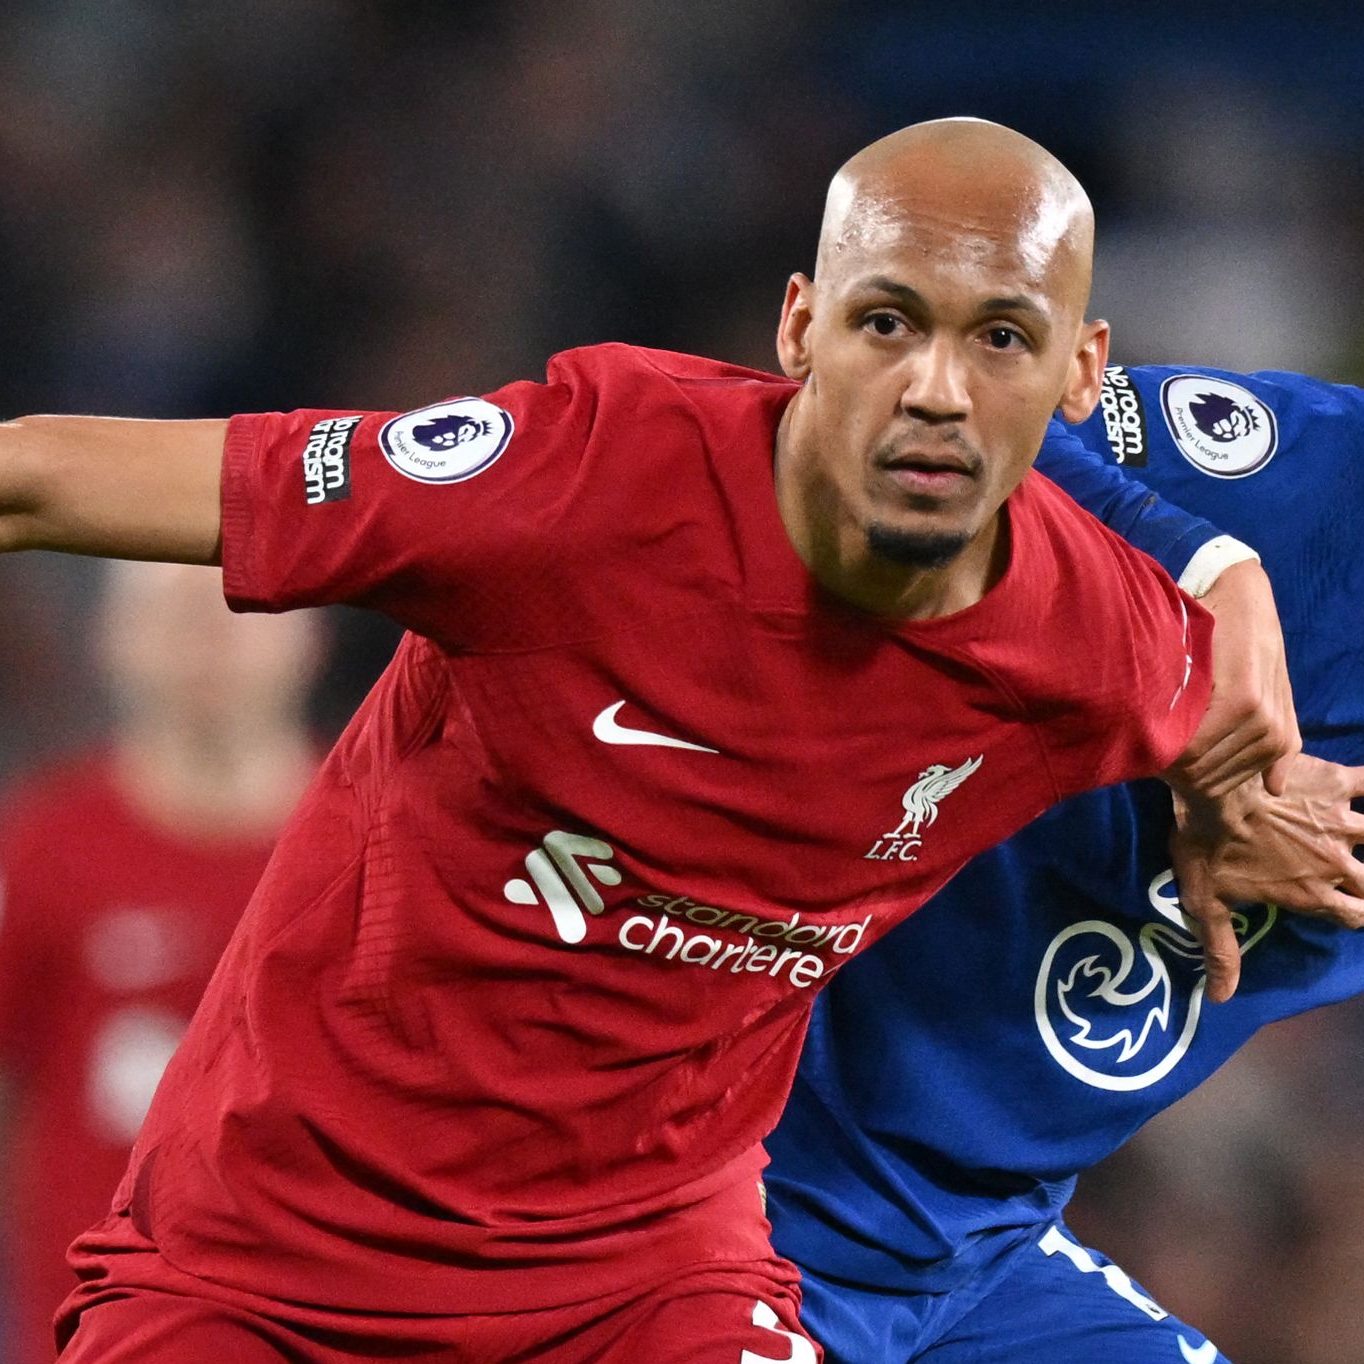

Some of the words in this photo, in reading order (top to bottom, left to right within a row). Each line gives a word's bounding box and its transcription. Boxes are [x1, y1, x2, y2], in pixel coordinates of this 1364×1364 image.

[1104, 366, 1129, 387] No
[1100, 385, 1125, 464] racism
[1116, 388, 1143, 455] room
[1176, 406, 1196, 442] Premier
[1195, 440, 1229, 461] League
[303, 433, 326, 504] racism
[323, 431, 349, 489] room
[409, 452, 446, 469] League
[619, 914, 842, 988] chartere
[637, 894, 873, 954] standard
